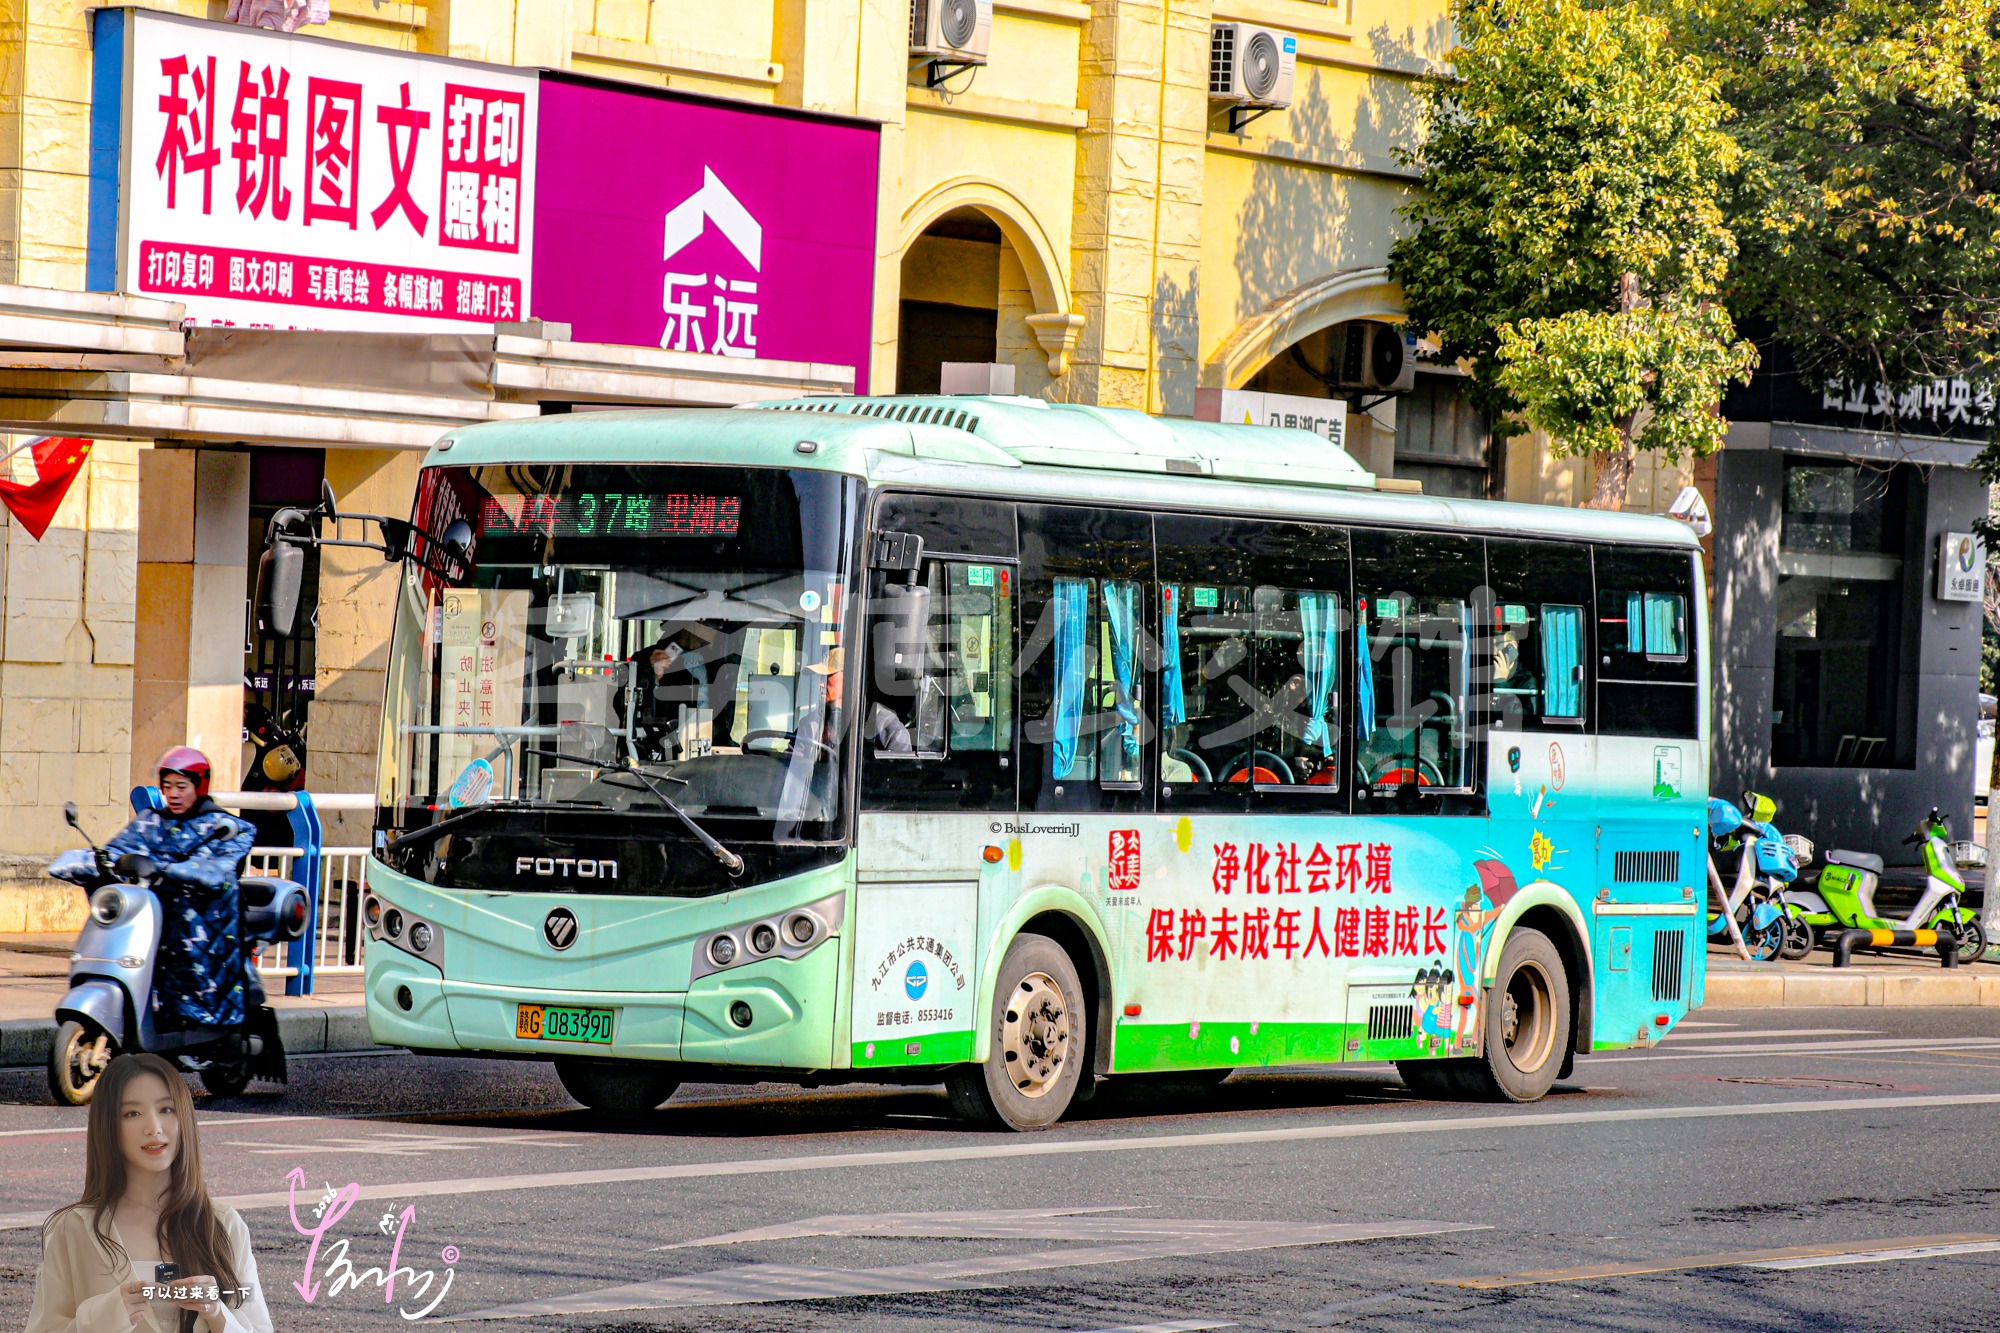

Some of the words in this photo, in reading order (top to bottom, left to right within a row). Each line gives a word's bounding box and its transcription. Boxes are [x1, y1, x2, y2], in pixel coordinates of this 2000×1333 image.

[155, 53, 431, 239] 科锐图文
[447, 93, 521, 167] 打印
[443, 170, 516, 245] 照相
[147, 247, 215, 291] 打印复印
[229, 256, 293, 299] 图文印刷
[307, 264, 371, 306] 写真喷绘
[382, 271, 444, 312] 条幅旗帜
[456, 279, 515, 319] 招牌门头
[659, 271, 758, 359] 乐远
[254, 676, 269, 689] 乐远
[301, 679, 316, 691] 乐远
[515, 856, 618, 879] FOTON
[1211, 841, 1393, 895] 净化社会环境
[1145, 904, 1448, 963] 保护未成年人健康成长
[871, 935, 966, 992] 九江市公共交通集团公司
